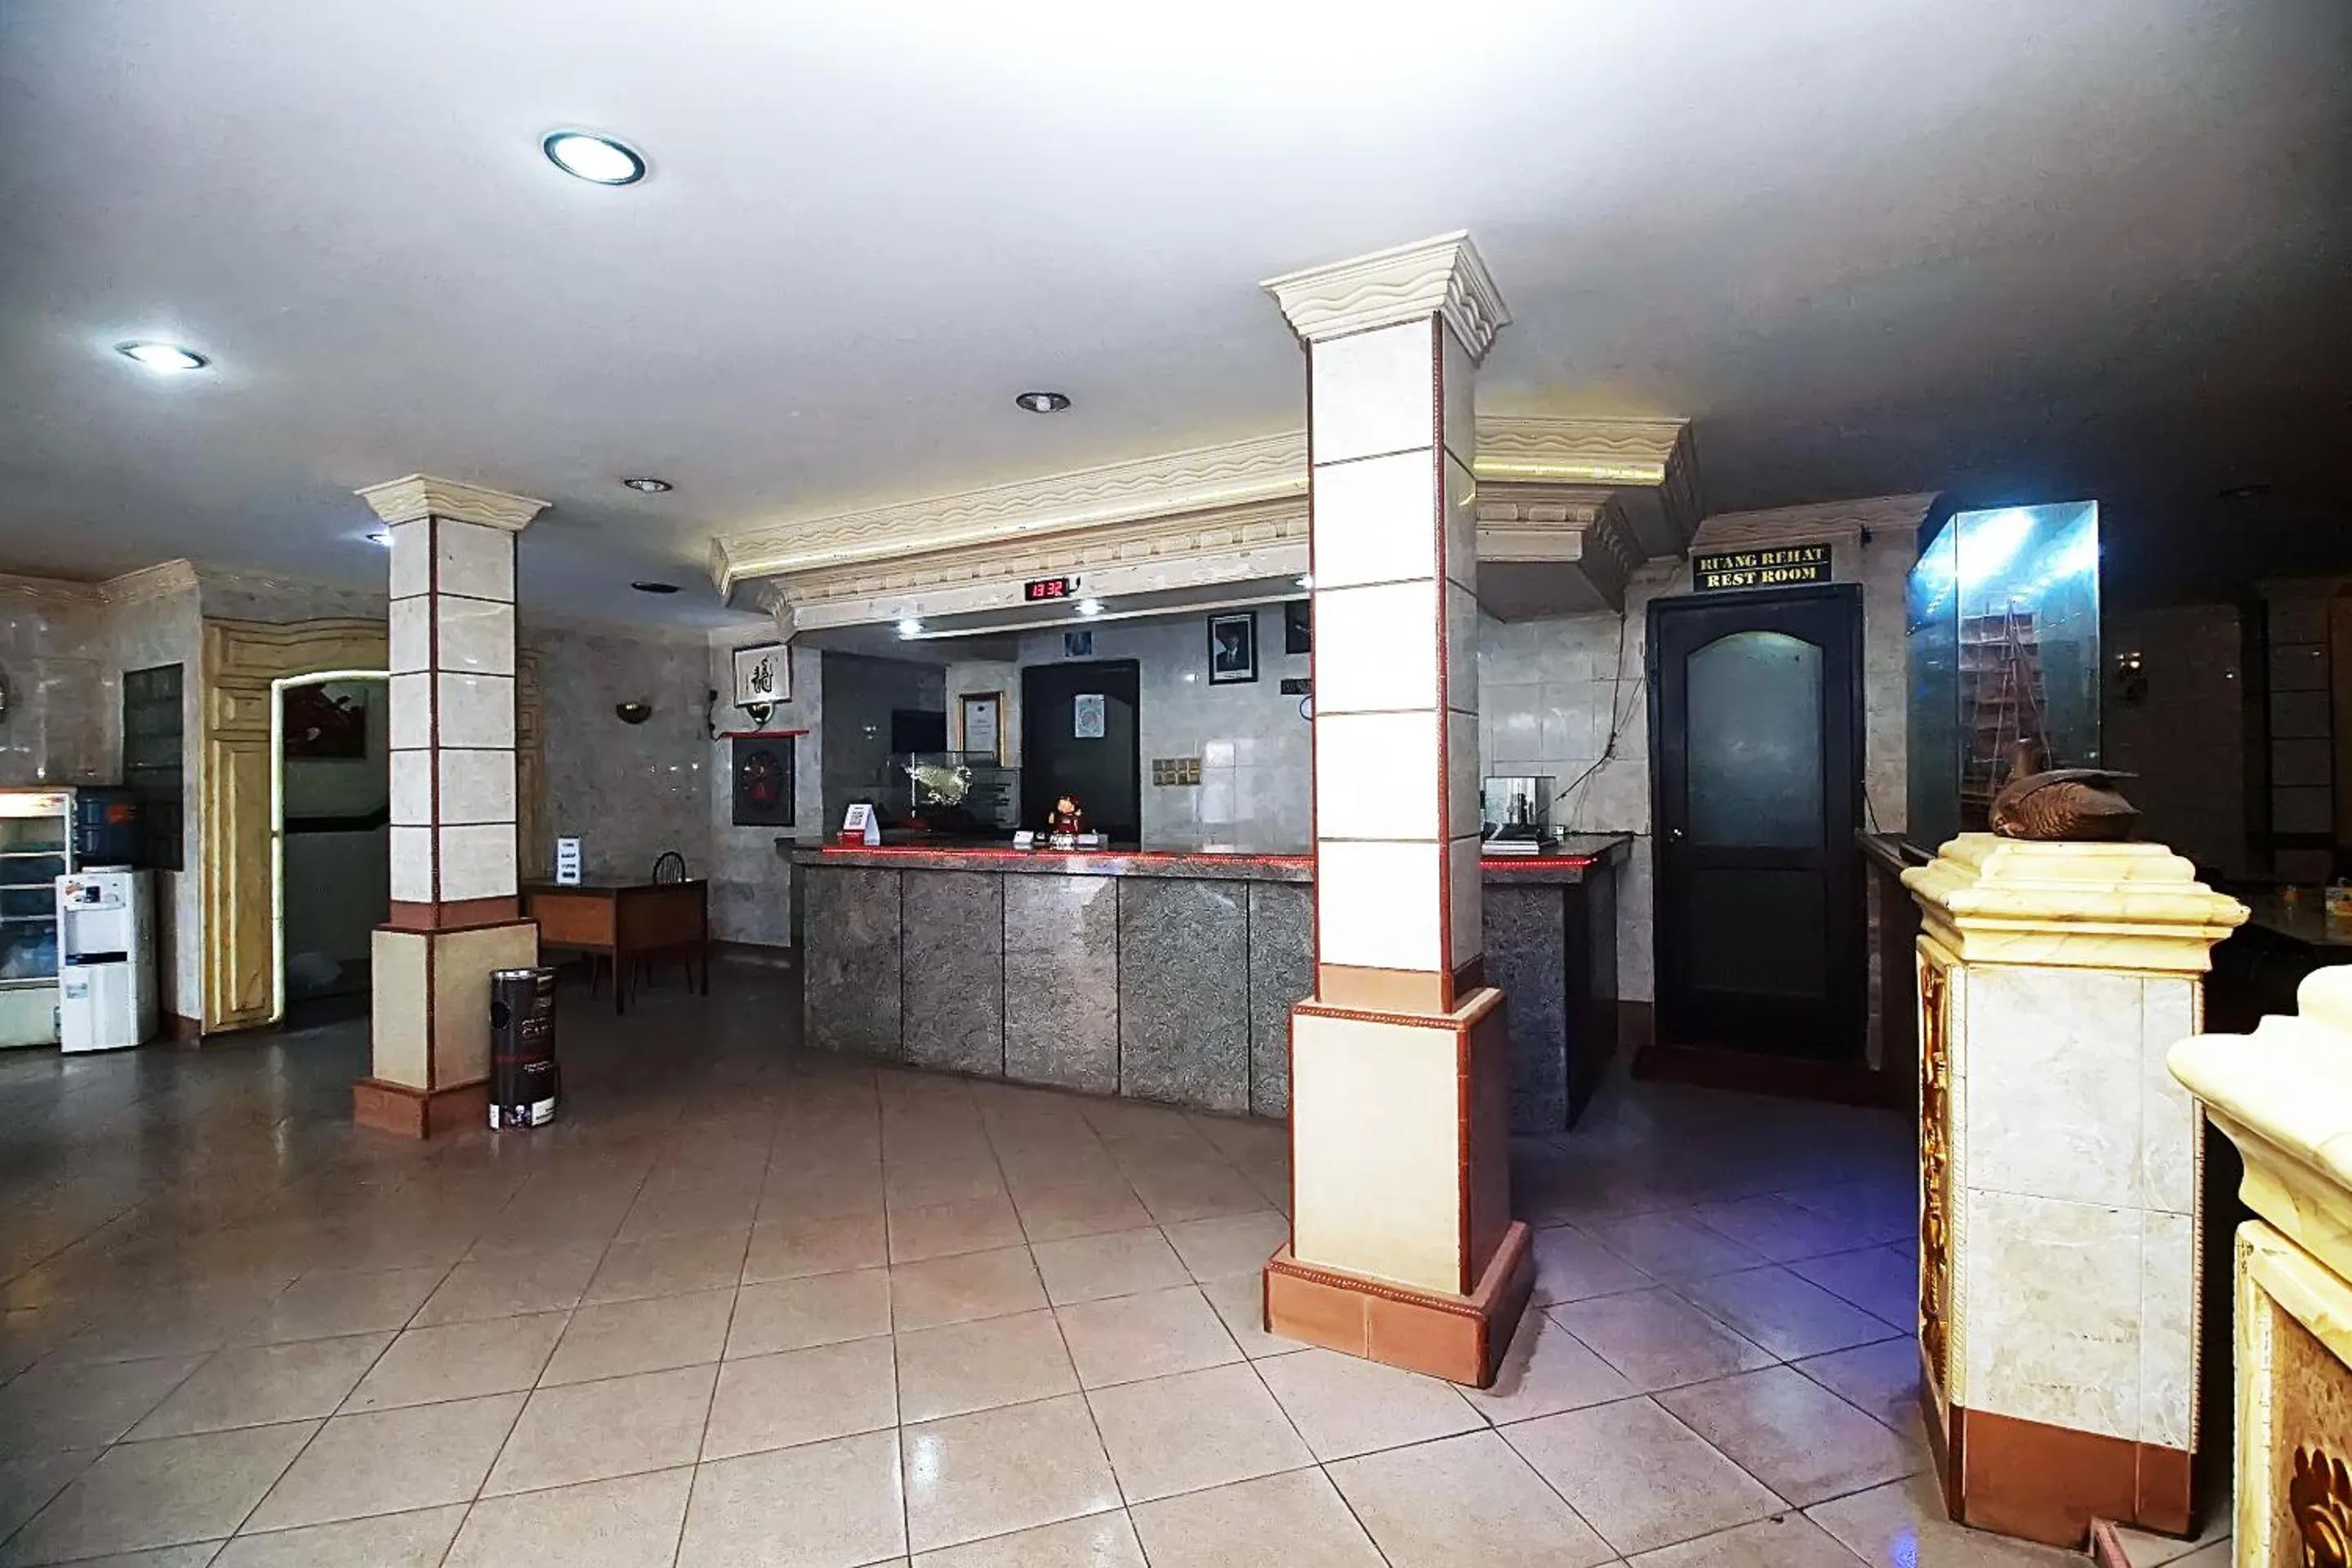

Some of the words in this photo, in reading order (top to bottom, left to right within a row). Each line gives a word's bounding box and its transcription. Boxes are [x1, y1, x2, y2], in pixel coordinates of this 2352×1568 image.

[1700, 555, 1757, 570] RUANG
[1762, 549, 1824, 564] REHAT
[1708, 573, 1756, 587] REST
[1762, 568, 1816, 582] ROOM
